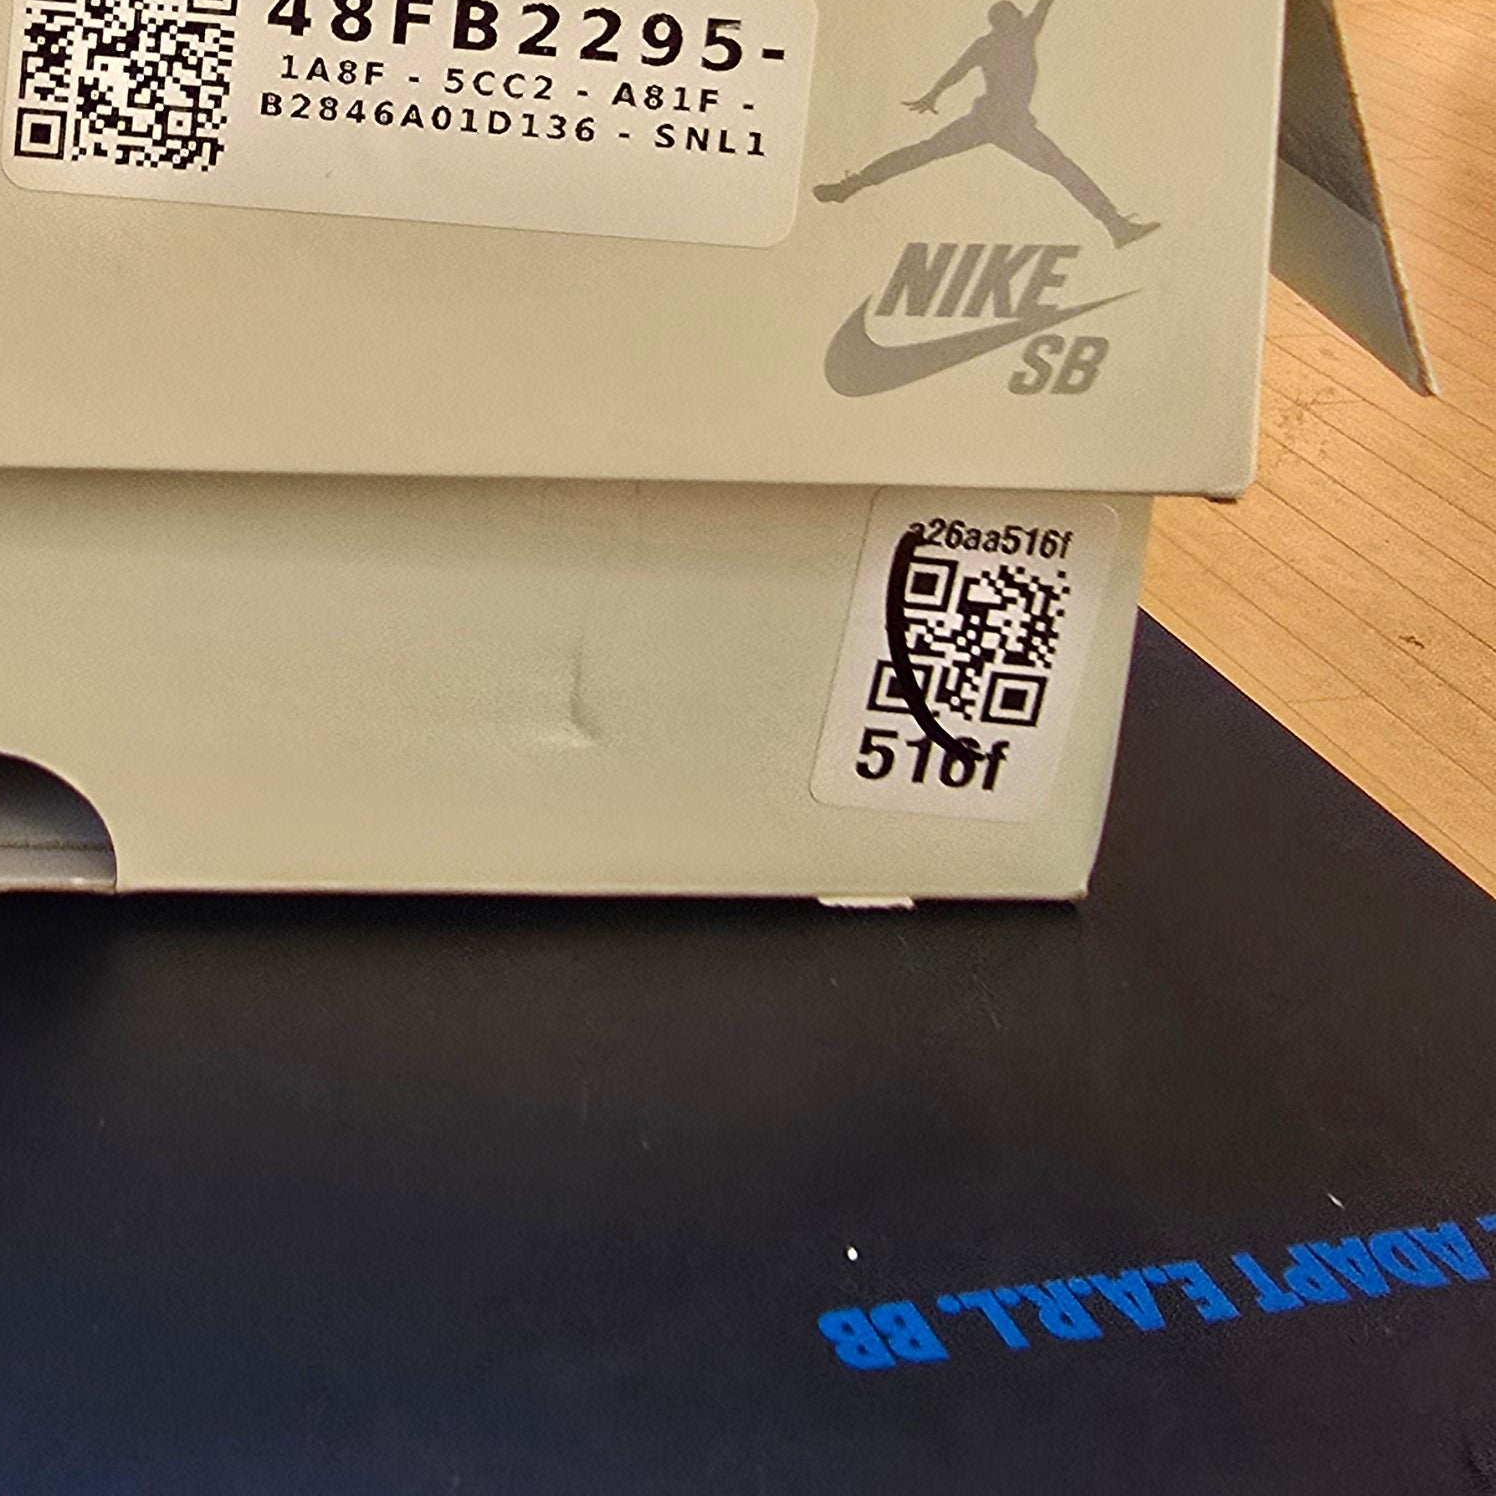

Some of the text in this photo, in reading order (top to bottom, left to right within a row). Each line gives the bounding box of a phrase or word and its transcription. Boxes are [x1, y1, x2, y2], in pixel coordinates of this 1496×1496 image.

[280, 53, 385, 87] 1A8F
[444, 68, 554, 101] 5CC2
[610, 82, 720, 114] A81F
[259, 91, 596, 143] B2846A01D136
[654, 123, 766, 157] SNL1
[873, 242, 1081, 318] NIKE
[1007, 333, 1109, 396] SB
[1231, 1221, 1491, 1314] ADAPT
[818, 1299, 951, 1370] BB
